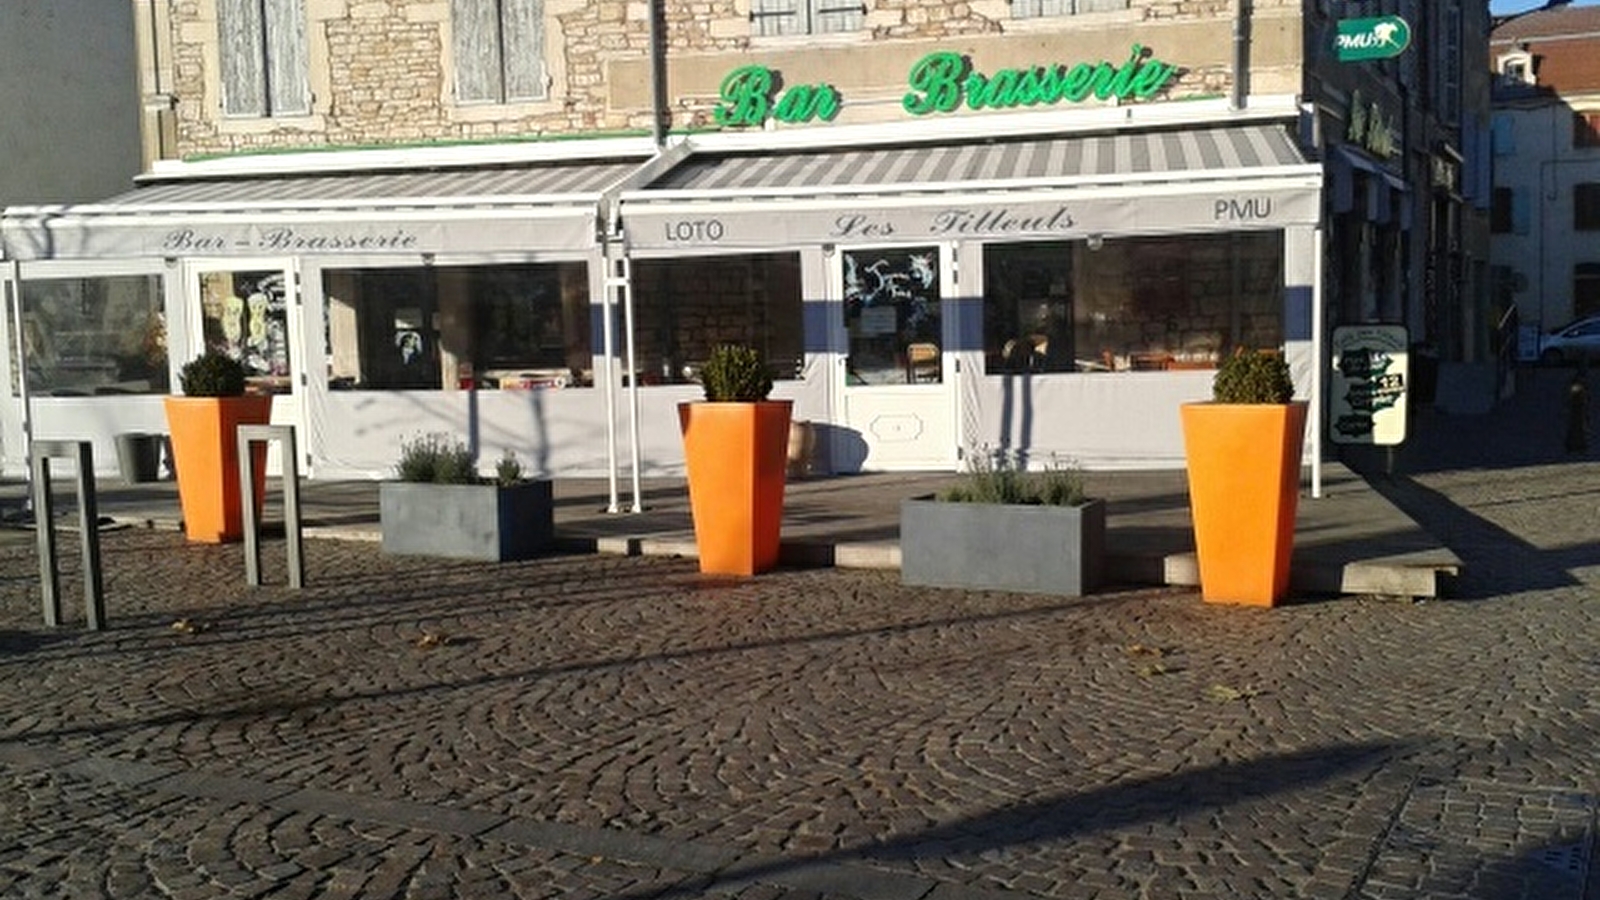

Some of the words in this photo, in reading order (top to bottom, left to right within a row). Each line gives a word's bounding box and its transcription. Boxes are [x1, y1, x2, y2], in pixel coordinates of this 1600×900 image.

[1336, 33, 1373, 49] PMU
[714, 65, 840, 126] Bar
[902, 43, 1177, 114] Brasserie
[665, 220, 724, 242] LOTO
[829, 213, 896, 237] Les
[930, 206, 1077, 235] Tilleuls
[1214, 198, 1272, 220] PMU
[163, 230, 226, 250] Bar
[258, 228, 418, 249] Brasserie
